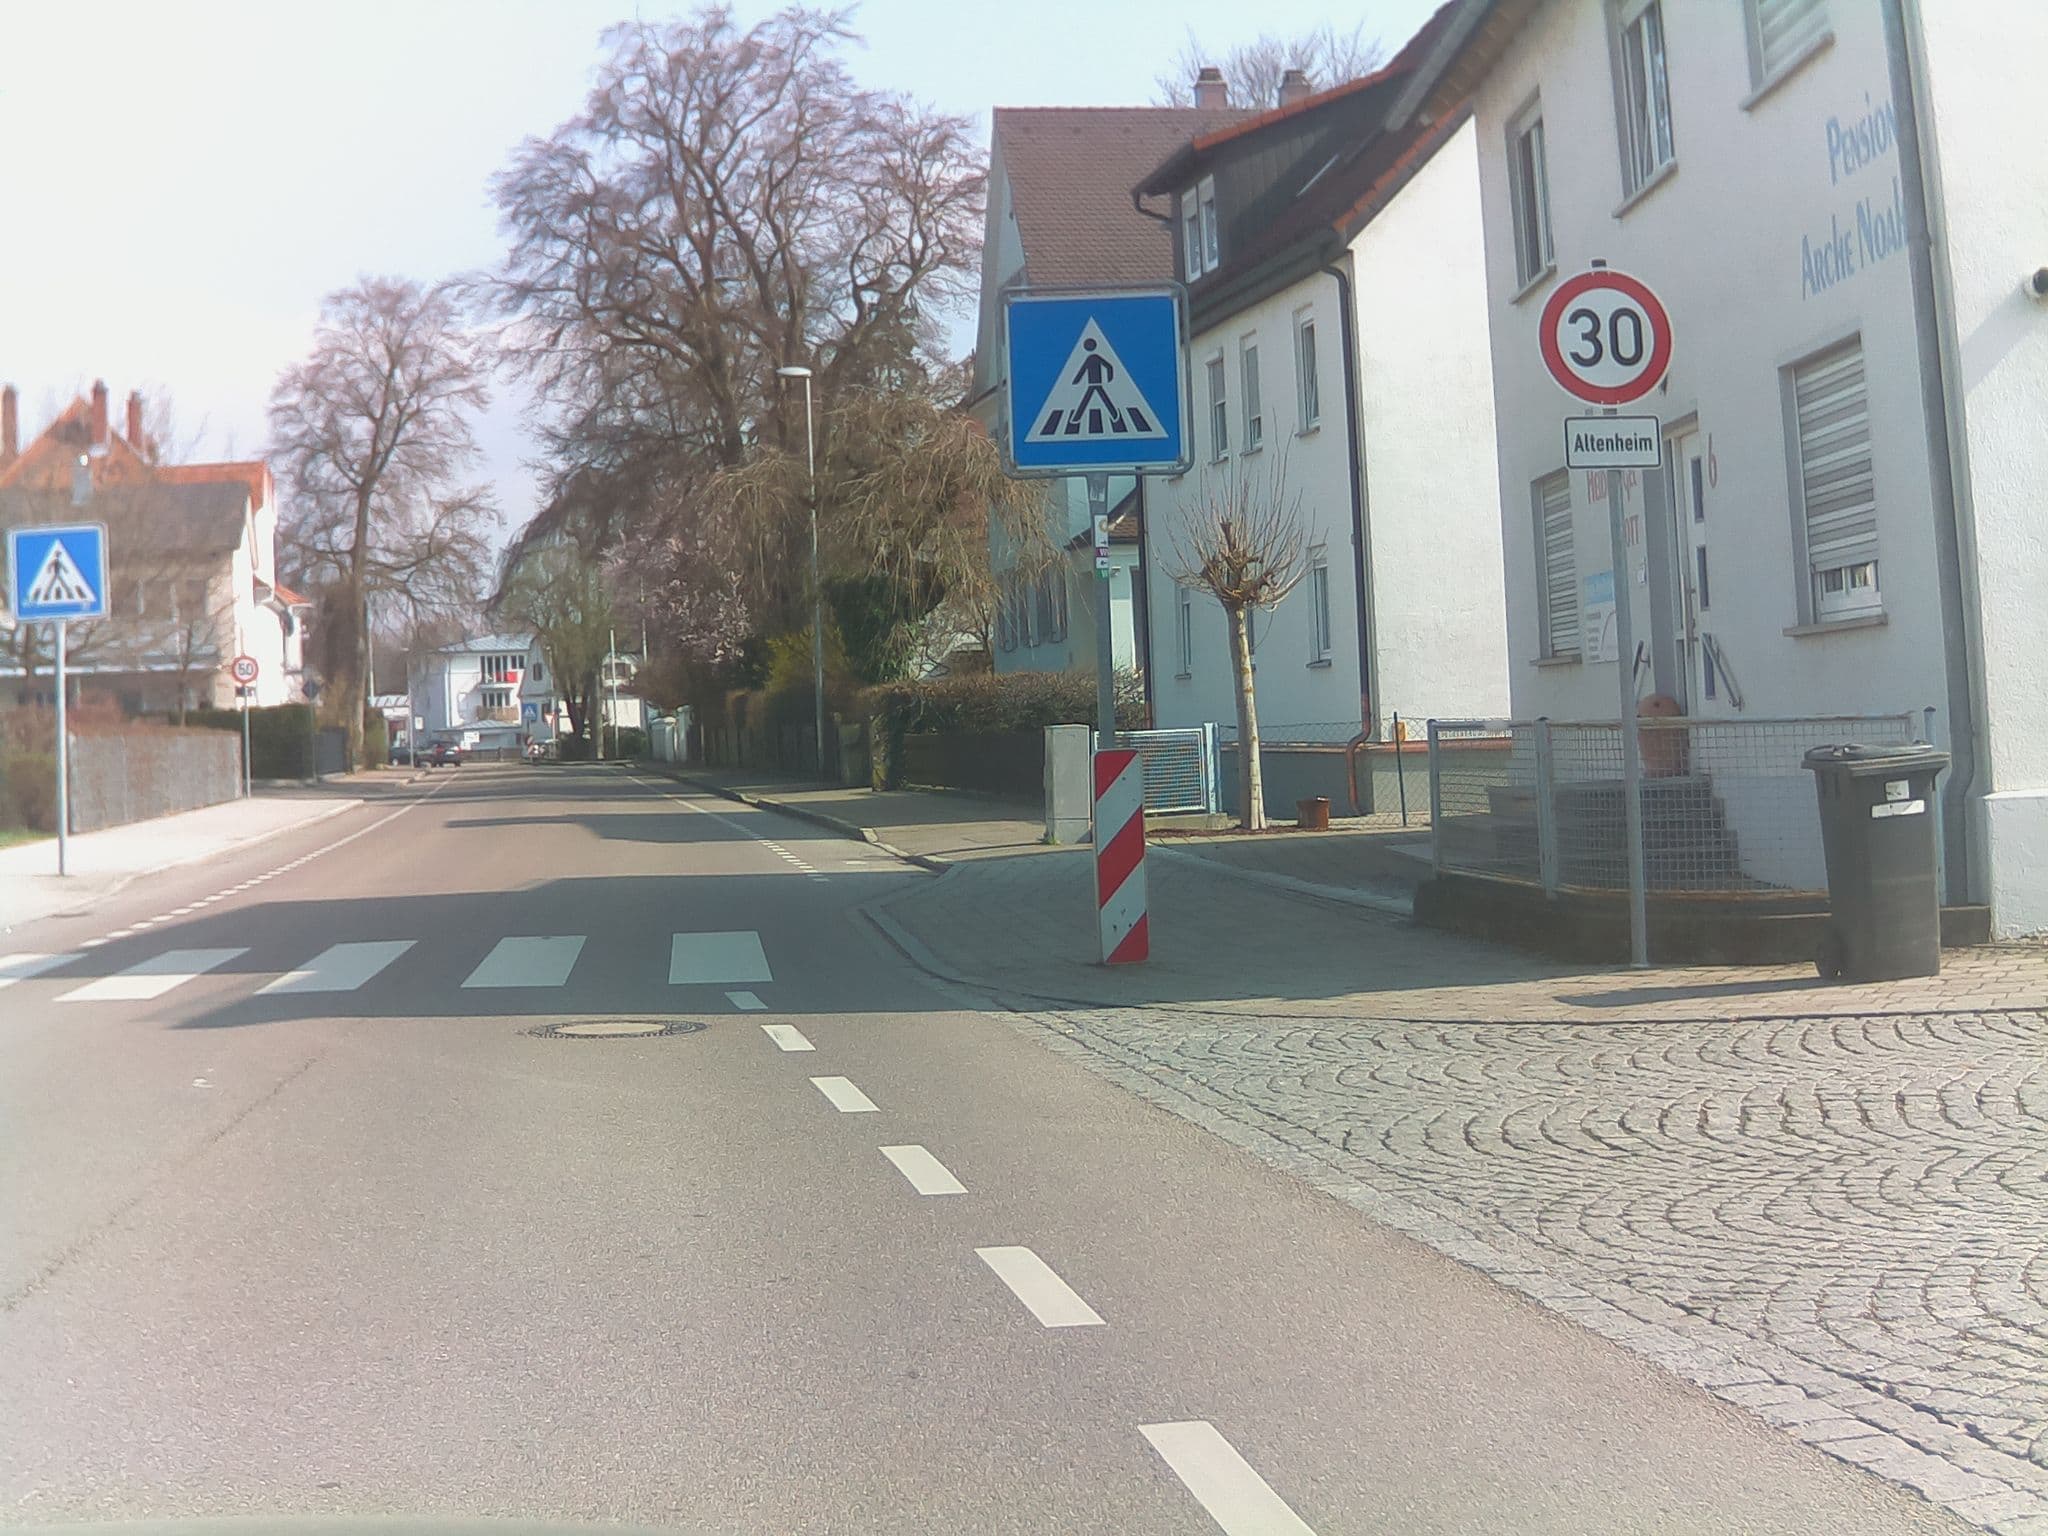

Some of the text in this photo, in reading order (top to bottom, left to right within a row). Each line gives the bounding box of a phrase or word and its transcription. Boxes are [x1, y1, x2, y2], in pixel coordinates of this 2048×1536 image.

[1568, 307, 1643, 367] 30
[1573, 432, 1653, 453] Altenheim
[238, 662, 254, 676] 50
